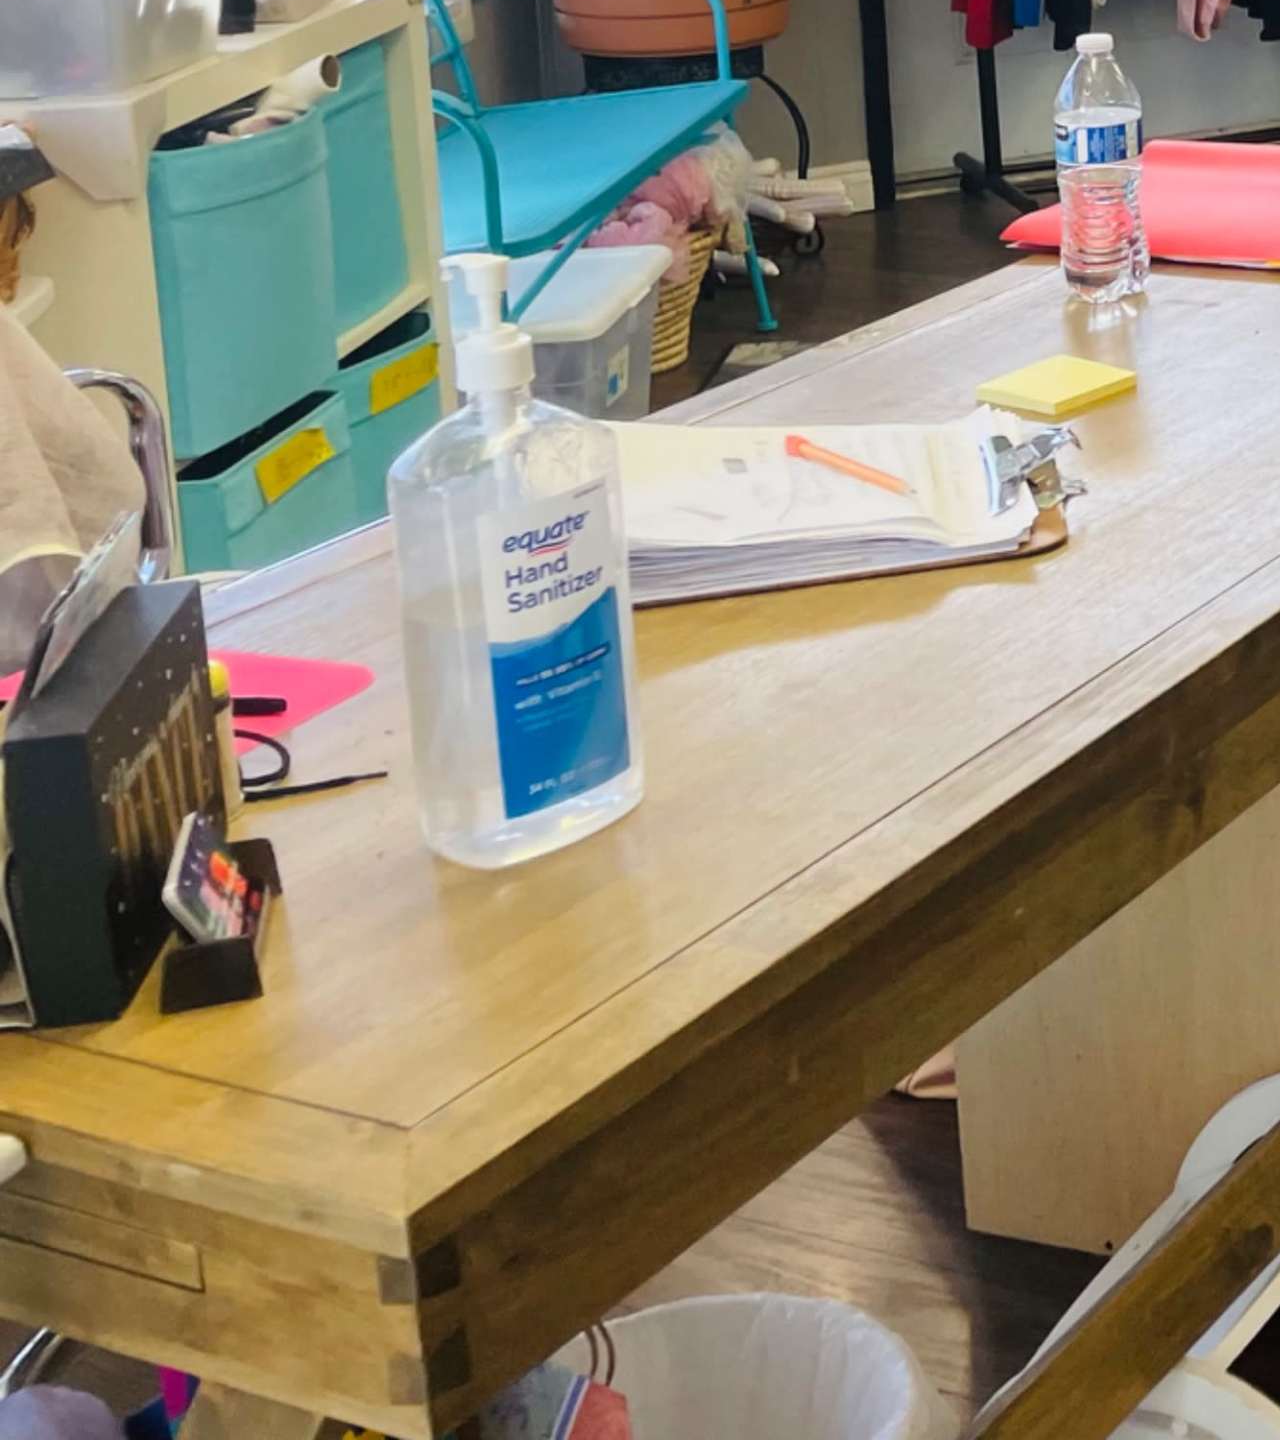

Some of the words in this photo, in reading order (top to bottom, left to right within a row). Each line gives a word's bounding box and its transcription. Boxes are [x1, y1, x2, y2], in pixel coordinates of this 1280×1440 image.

[502, 511, 588, 554] equate
[504, 551, 568, 588] Hand
[507, 565, 603, 614] Sanitizer
